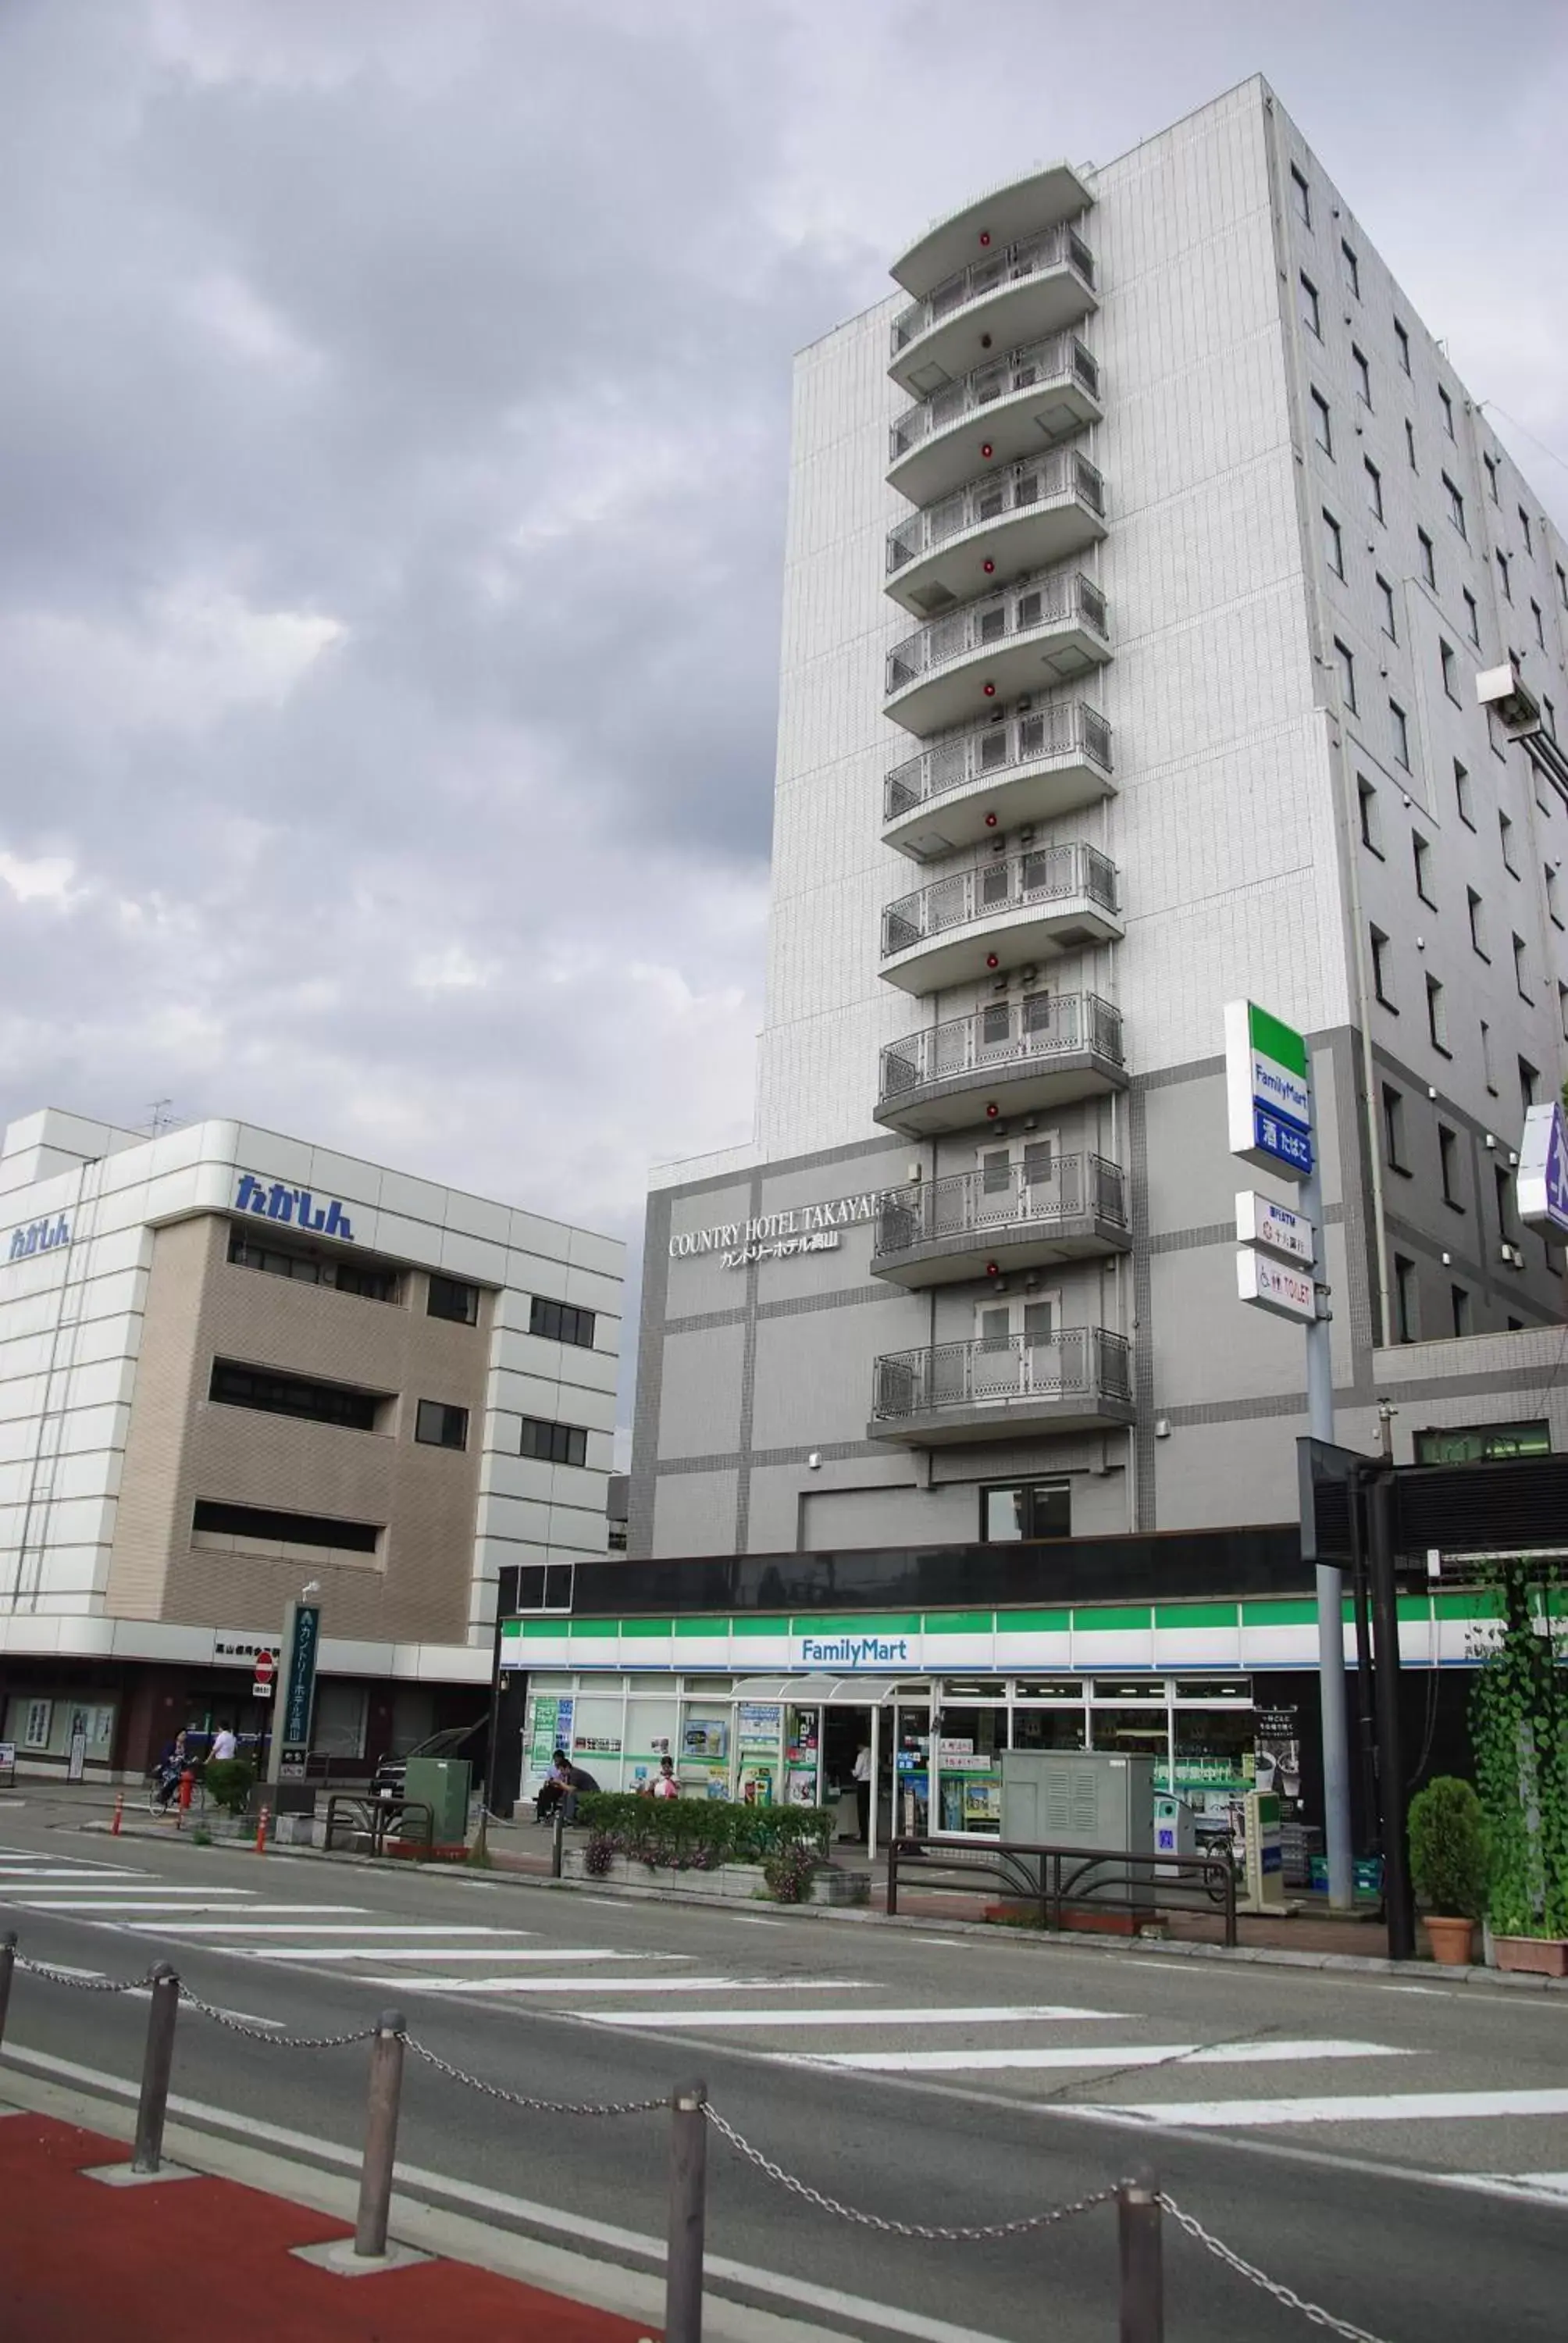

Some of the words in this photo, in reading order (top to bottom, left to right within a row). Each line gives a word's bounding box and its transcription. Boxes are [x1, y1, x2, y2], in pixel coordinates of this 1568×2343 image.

[1255, 1063, 1306, 1108] FamilyMart
[1263, 1118, 1277, 1149] 酒
[1281, 1134, 1308, 1162] たばこ
[236, 1174, 355, 1240] たかしん
[9, 1213, 69, 1260] たかしん
[669, 1222, 740, 1257] COUNTRY
[746, 1211, 797, 1241] HOTEL
[721, 1230, 837, 1268] カントリーホテル高山
[1285, 1277, 1310, 1305] TOILET
[803, 1639, 907, 1668] FamilyMart
